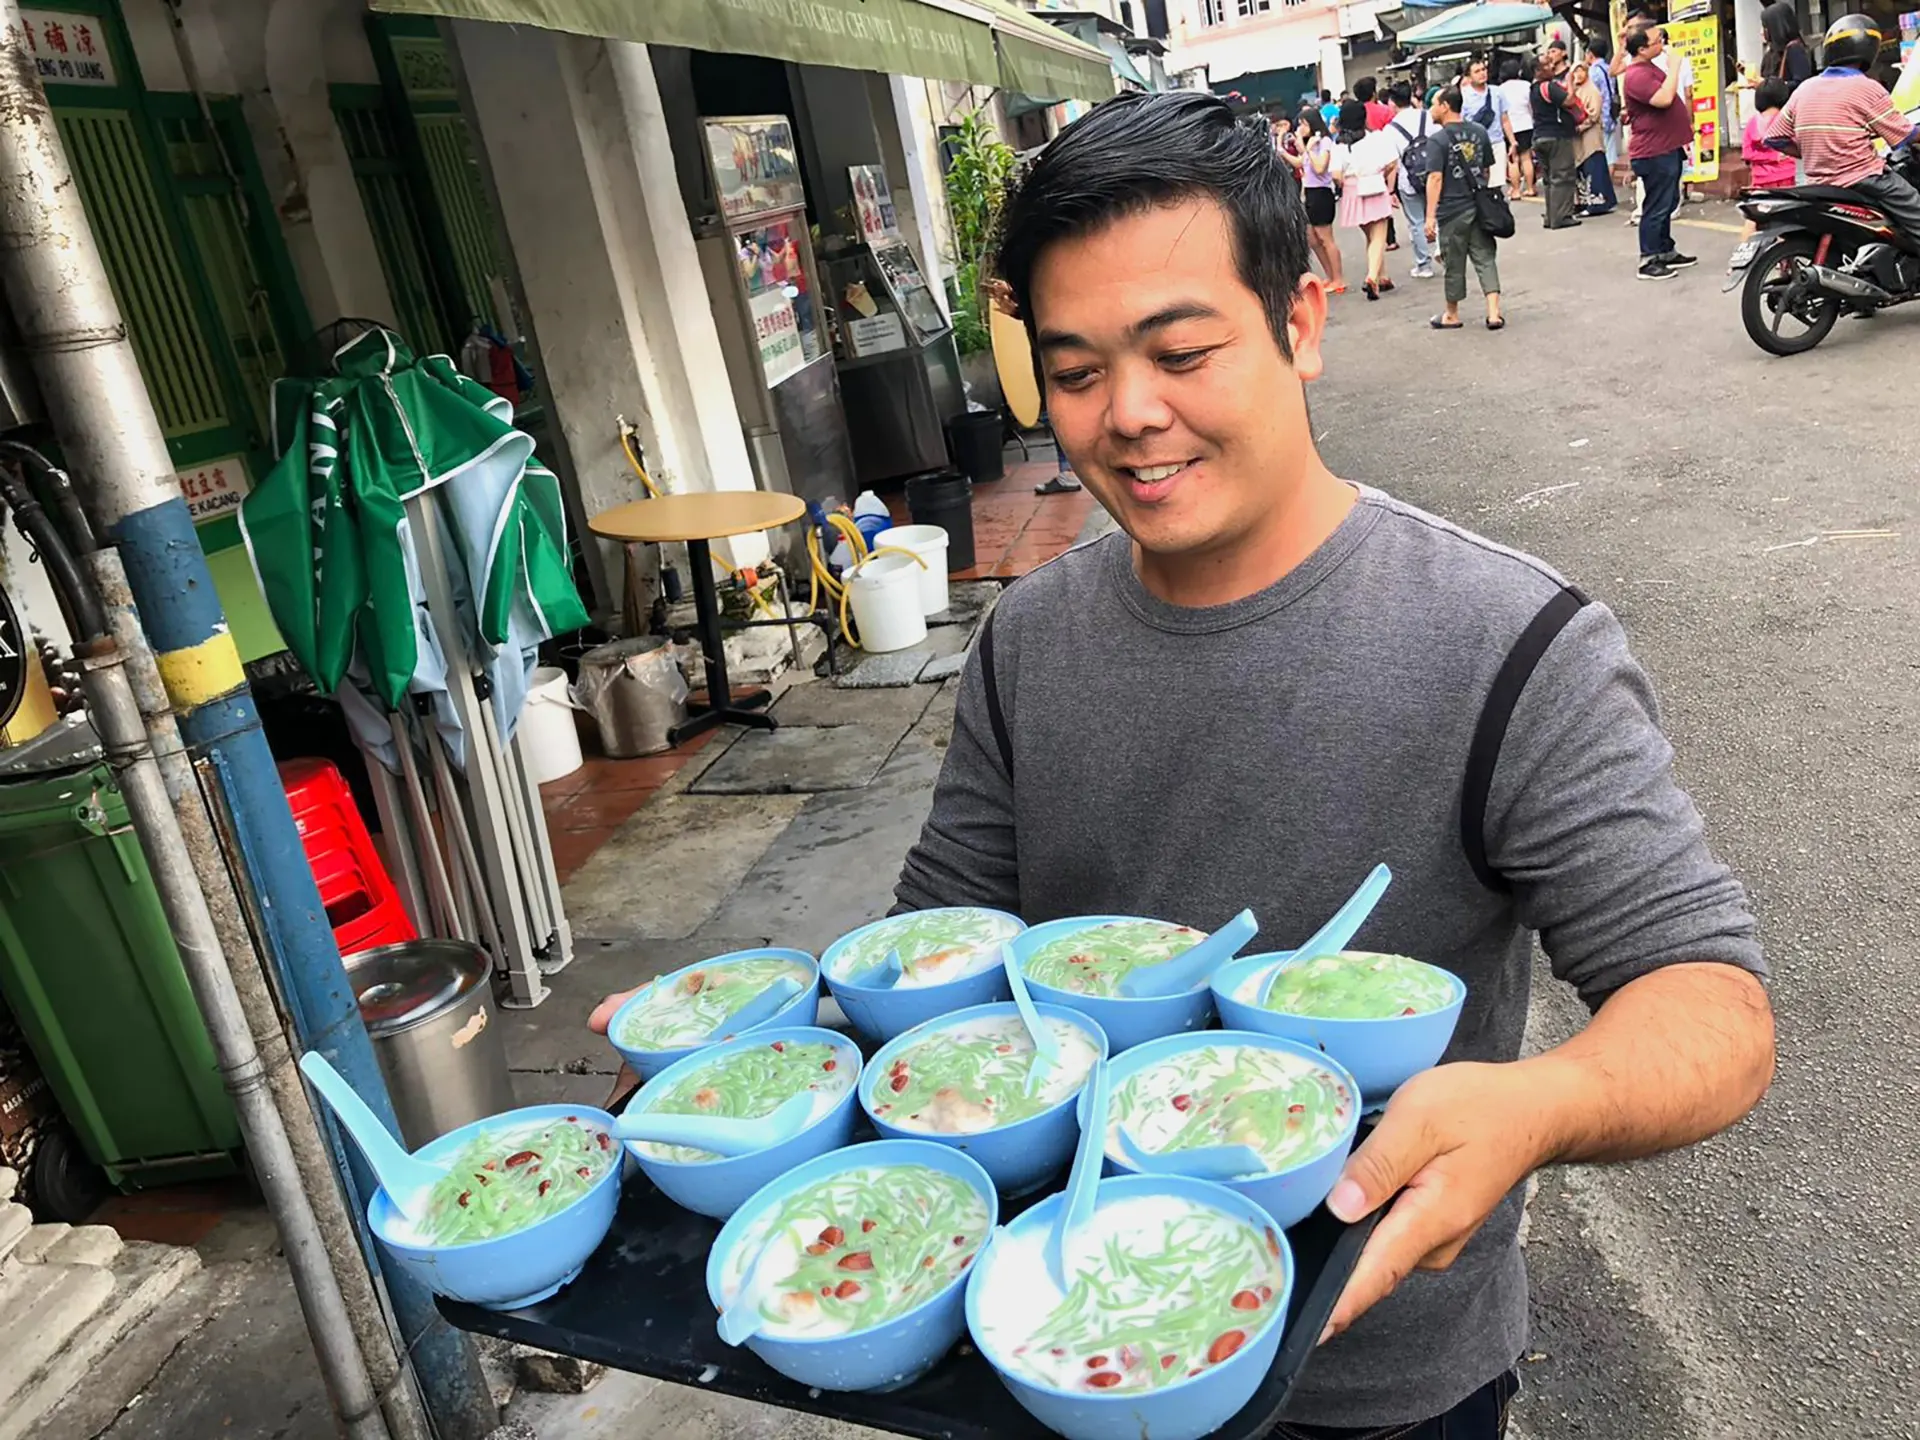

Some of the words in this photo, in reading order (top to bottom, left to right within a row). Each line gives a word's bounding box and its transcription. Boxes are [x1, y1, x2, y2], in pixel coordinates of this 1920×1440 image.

[35, 57, 57, 76] ENG
[58, 59, 74, 77] PO
[74, 61, 104, 80] LIANG
[198, 491, 240, 513] KACANG
